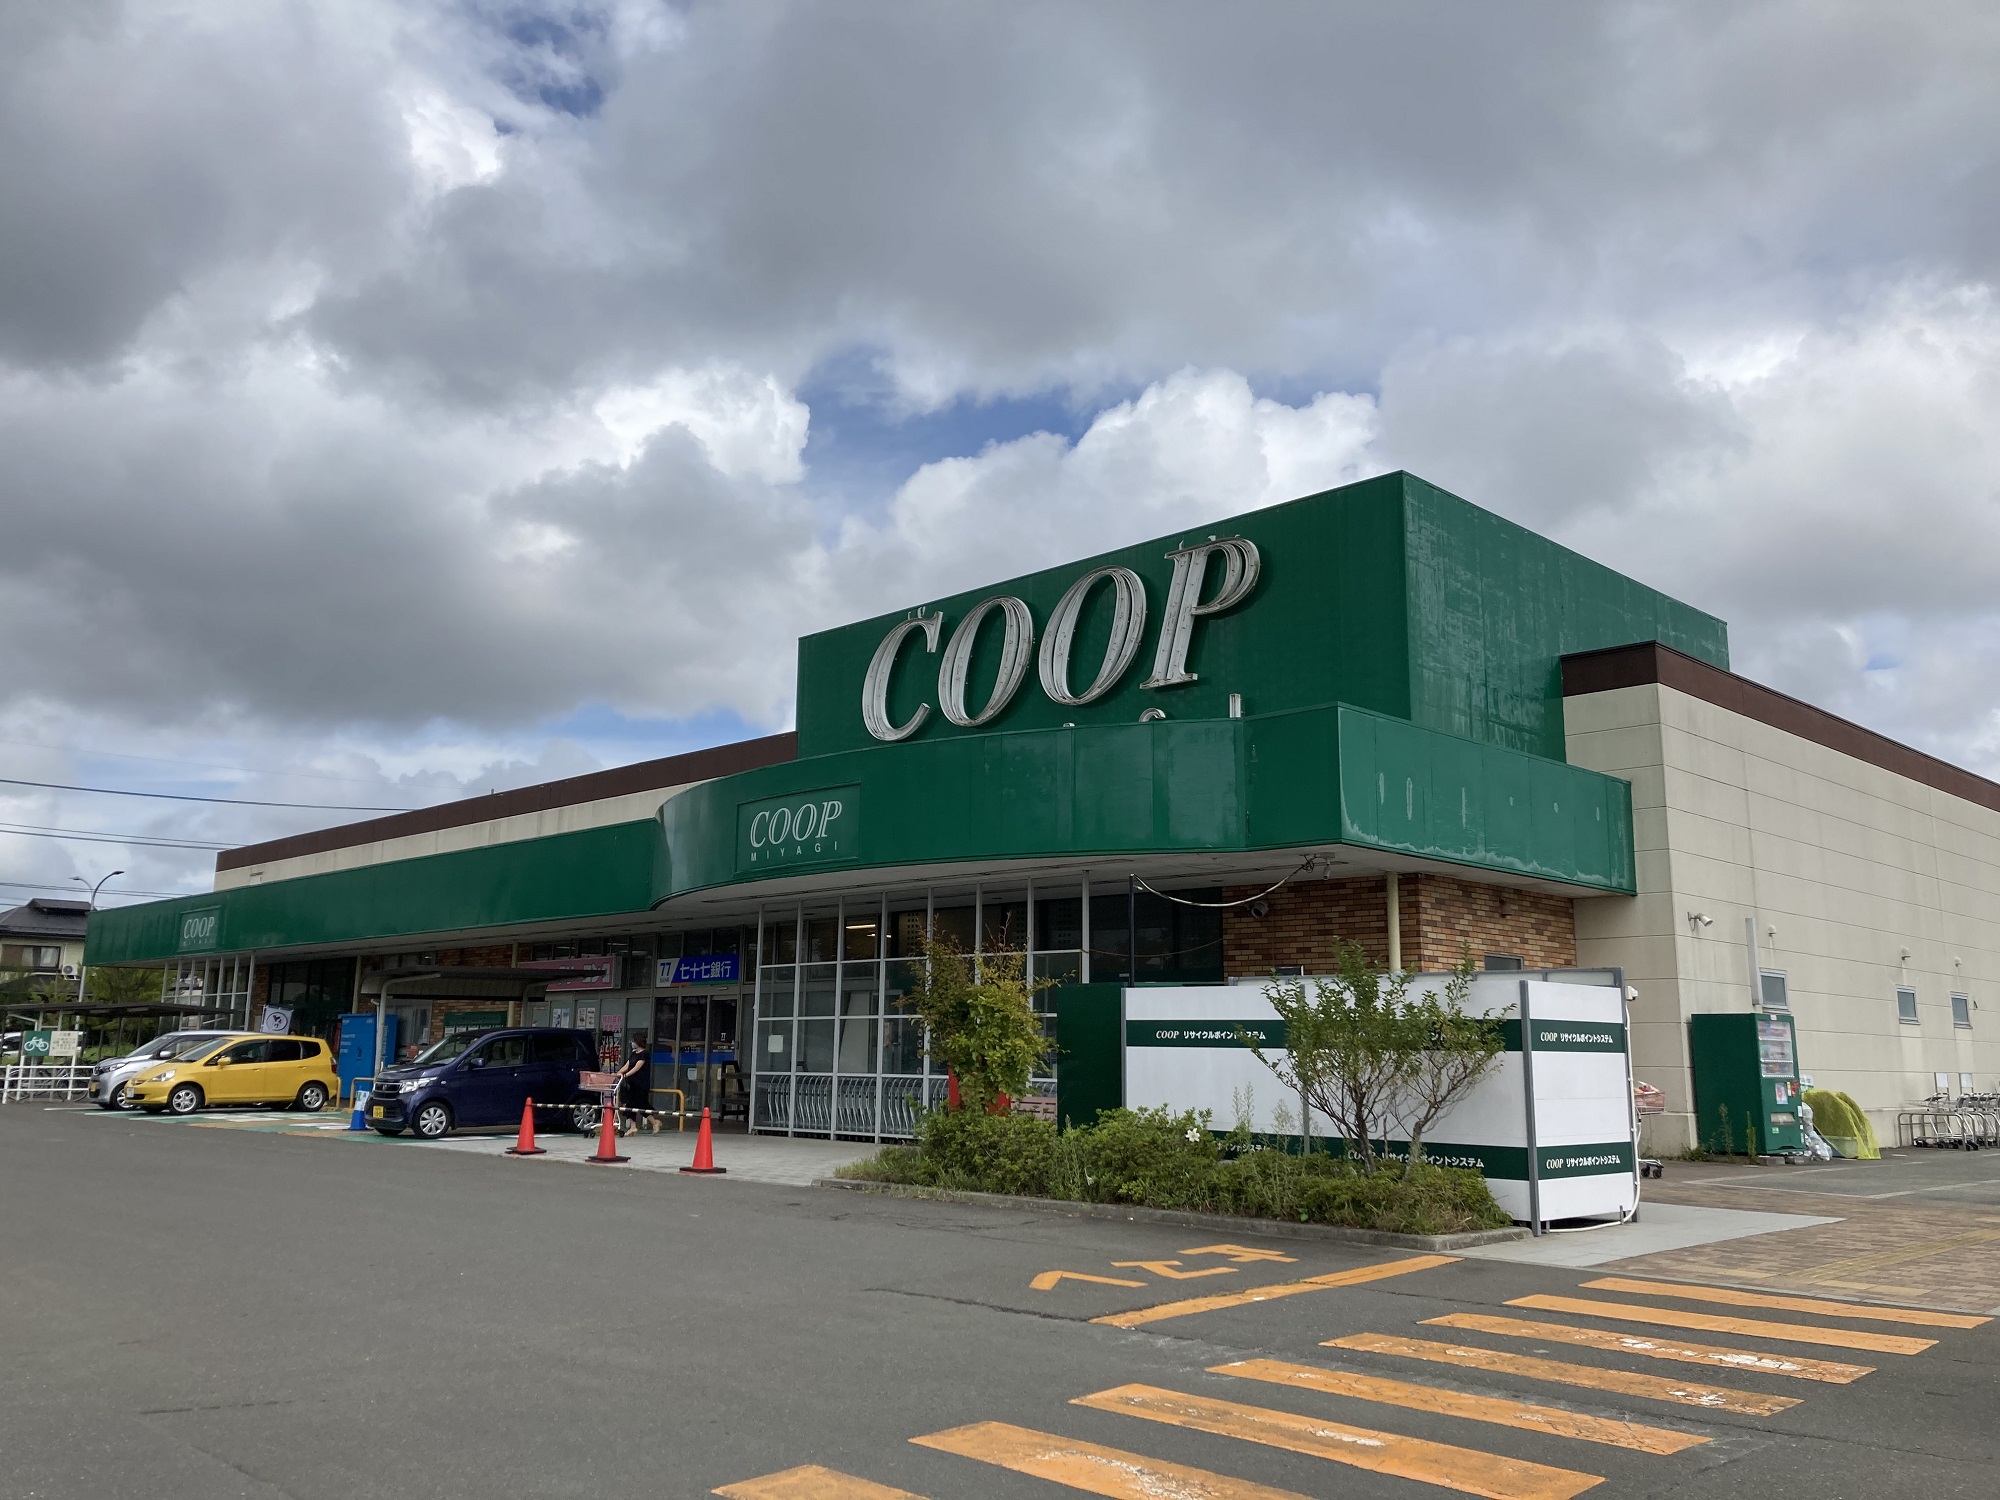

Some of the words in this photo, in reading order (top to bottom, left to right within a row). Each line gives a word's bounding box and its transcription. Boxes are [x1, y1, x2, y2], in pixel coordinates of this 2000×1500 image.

[861, 534, 1261, 742] COOP
[750, 800, 843, 848] COOP
[751, 840, 838, 862] MIYAGI
[183, 916, 215, 939] COOP
[680, 960, 732, 980] 七十七銀行
[1155, 1030, 1180, 1039] COOP
[1183, 1030, 1267, 1040] リサイクルポイントステム
[1540, 1031, 1558, 1042] COOP
[1559, 1032, 1614, 1044] リサイクルポイントシステム
[1546, 1158, 1564, 1170] COOP
[1566, 1154, 1621, 1168] リサイクルポイントシステム
